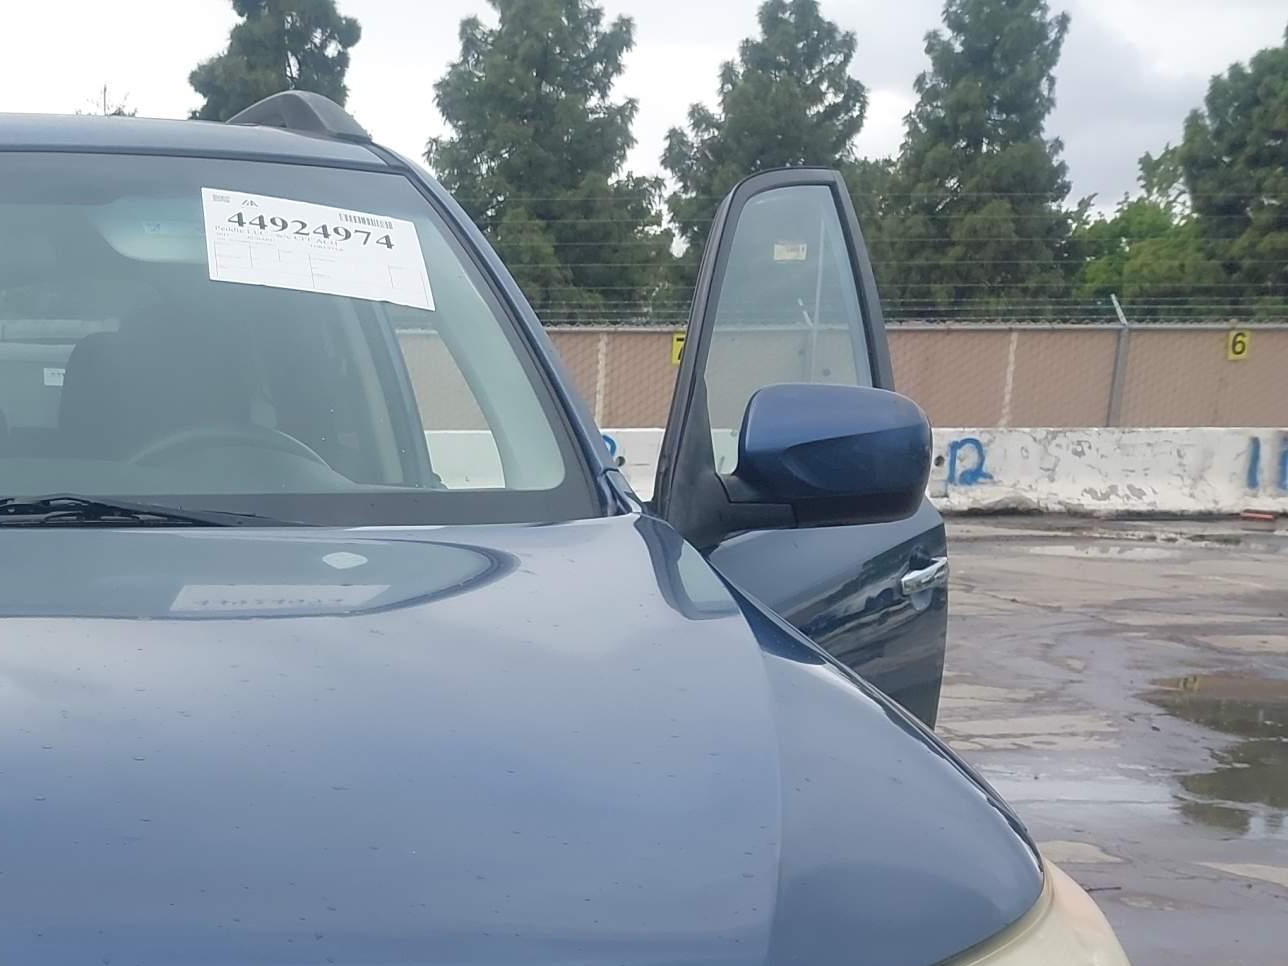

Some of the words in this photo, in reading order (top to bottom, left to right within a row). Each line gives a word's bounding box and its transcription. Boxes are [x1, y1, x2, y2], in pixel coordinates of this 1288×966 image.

[227, 212, 394, 249] 44924974
[1232, 332, 1246, 355] 6
[947, 437, 993, 486] 12
